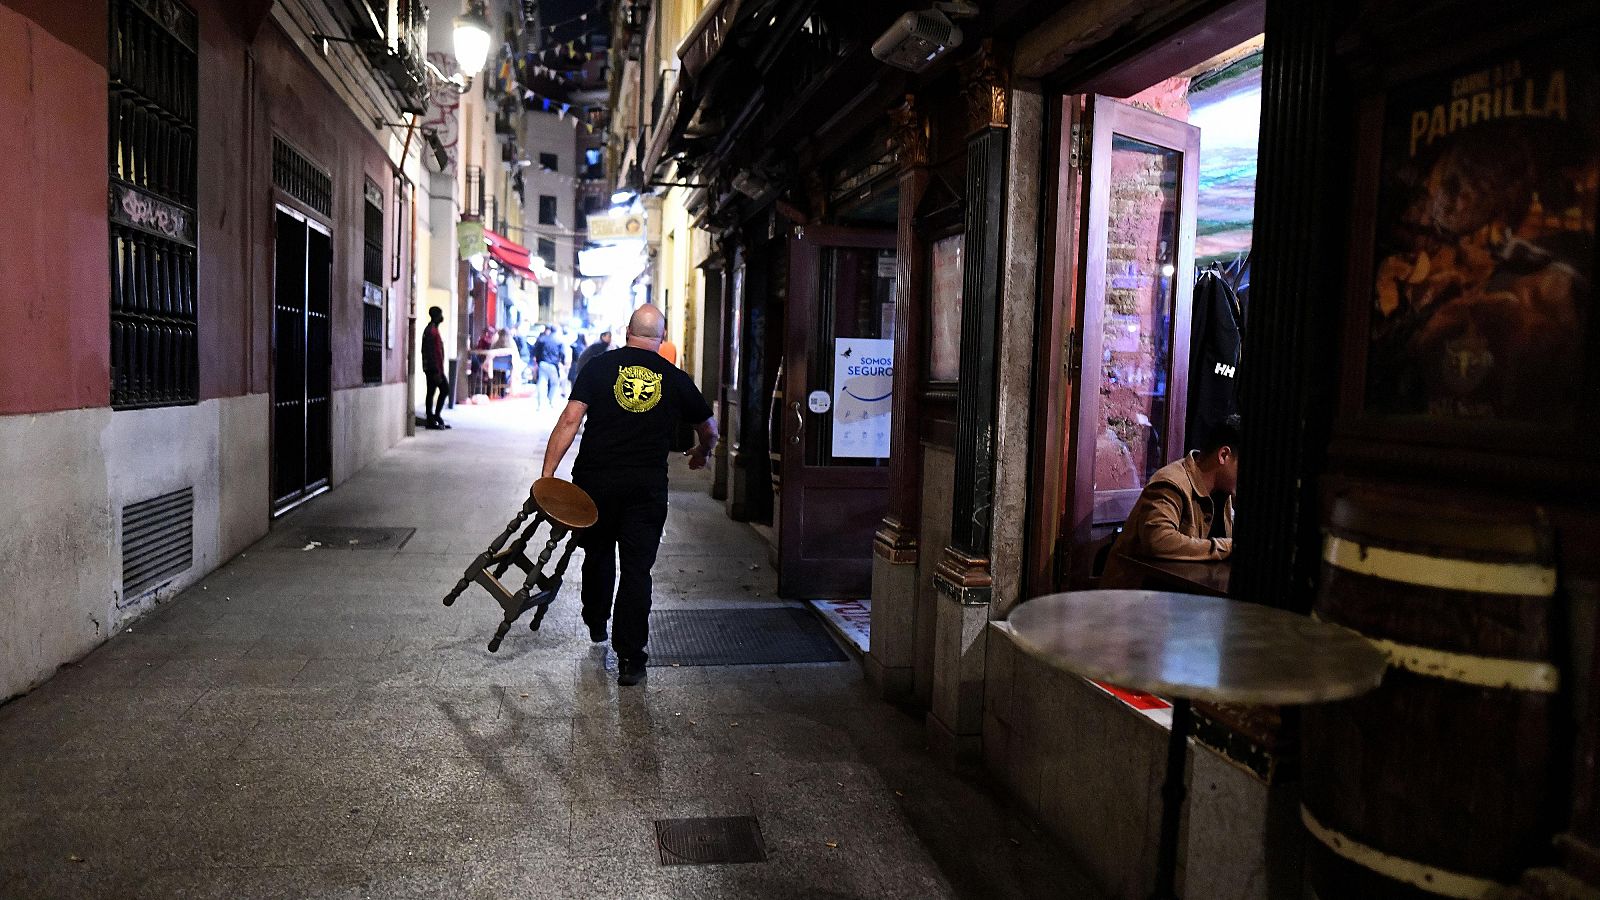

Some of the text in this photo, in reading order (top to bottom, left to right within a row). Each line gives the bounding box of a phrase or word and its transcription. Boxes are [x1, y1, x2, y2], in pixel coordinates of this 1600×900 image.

[1410, 69, 1568, 157] PARRILLA
[861, 357, 892, 366] SOMOS
[848, 366, 895, 377] SEGURO
[1214, 362, 1236, 379] HH
